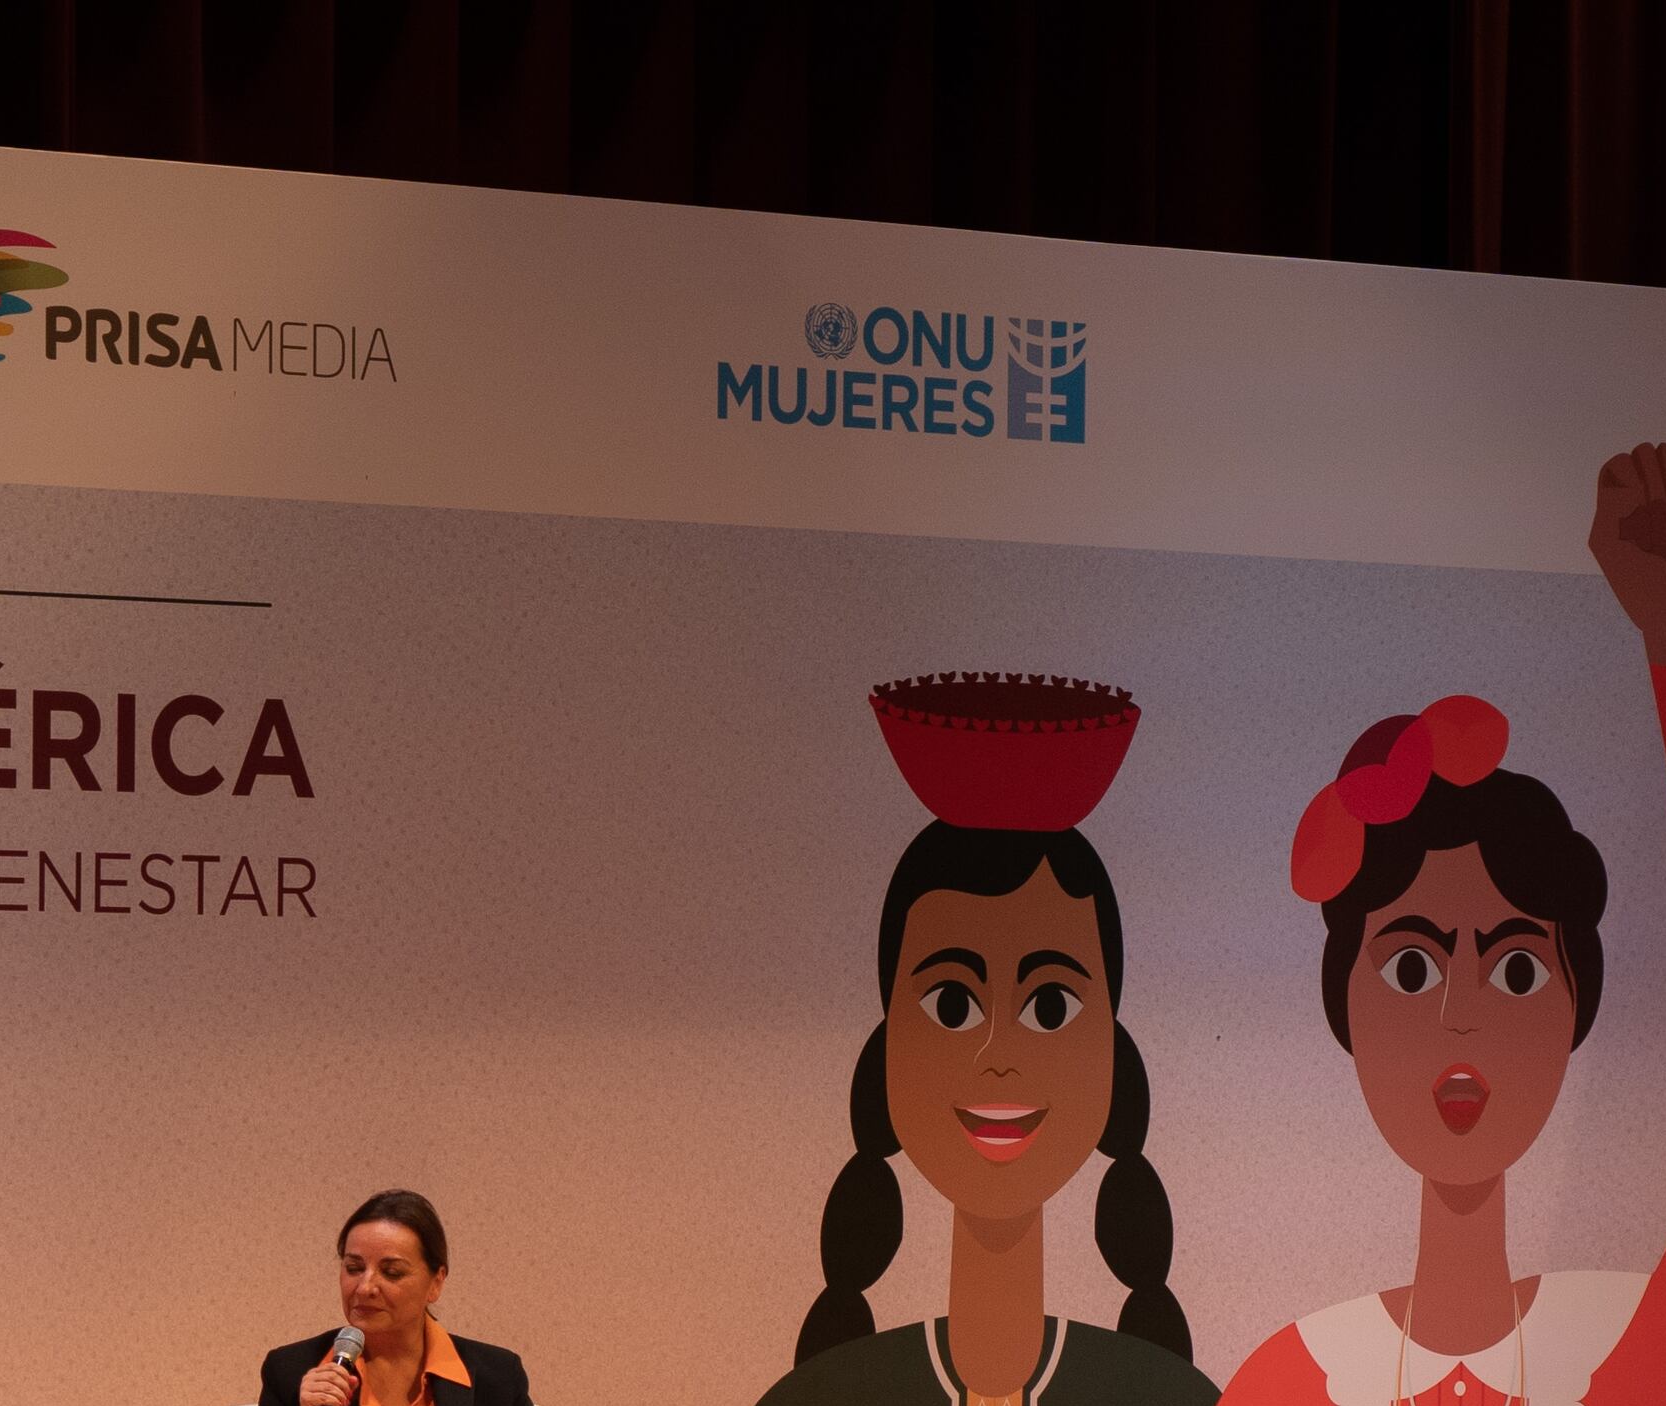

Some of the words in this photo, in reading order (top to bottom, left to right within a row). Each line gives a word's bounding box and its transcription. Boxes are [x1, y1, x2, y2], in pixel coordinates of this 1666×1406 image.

[46, 306, 222, 371] PRISA
[233, 318, 397, 382] MEDIA
[864, 307, 993, 372] ONU
[717, 362, 994, 437] MUJERES
